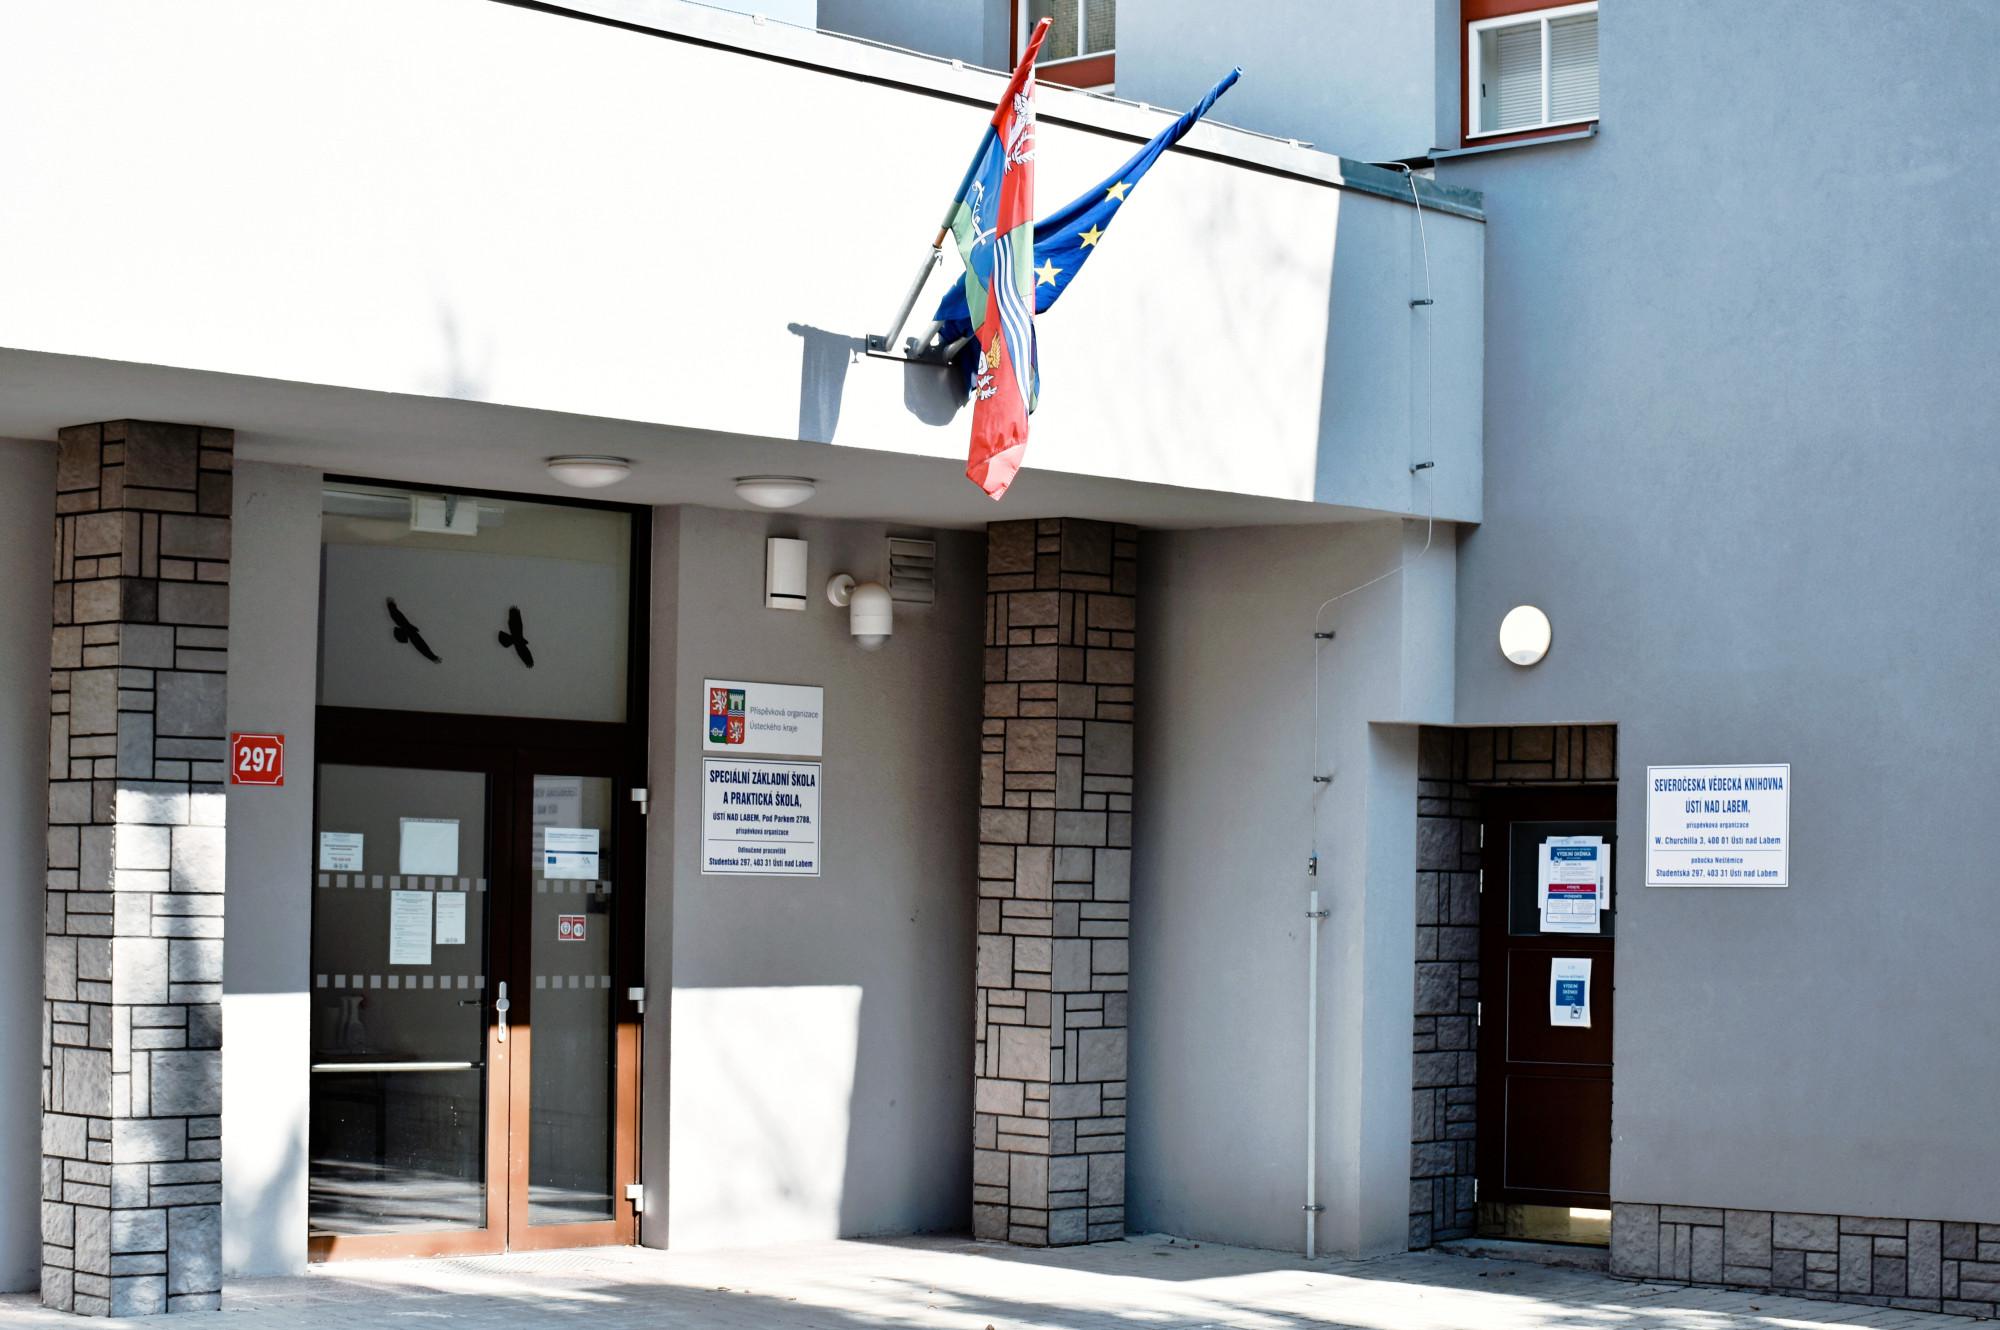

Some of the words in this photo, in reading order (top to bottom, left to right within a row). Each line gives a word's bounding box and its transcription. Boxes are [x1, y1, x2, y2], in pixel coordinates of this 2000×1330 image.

[750, 707, 785, 717] Příspěvková
[787, 709, 819, 719] organizace
[750, 720, 781, 731] Ústeckého
[783, 724, 798, 733] kraje
[240, 746, 277, 772] 297
[710, 768, 750, 784] SPECIÁLNÍ
[752, 769, 789, 786] ZÁKLADNÍ
[792, 771, 815, 787] ŠKOLA
[1654, 775, 1706, 792] SEVEROČESKÁ
[1708, 775, 1742, 791] VĚDECKÁ
[1744, 777, 1783, 790] KNIHOVNA
[723, 792, 728, 804] A
[731, 790, 773, 806] PRAKTICKÁ
[775, 791, 802, 808] ŠKOLA,
[1686, 797, 1702, 813] ÚSTÍ
[1704, 800, 1720, 813] NAD
[1722, 800, 1750, 813] LABEM,
[713, 811, 726, 821] ÚSTÍ
[727, 812, 738, 821] NAD
[762, 814, 772, 823] Pod
[774, 815, 795, 823] Parkem
[1665, 836, 1698, 844] Churchilla
[1731, 835, 1743, 844] Ústí
[709, 857, 739, 866] Studentská
[753, 859, 763, 867] 403
[765, 859, 771, 867] 31
[773, 858, 783, 867] Ústí
[784, 859, 794, 867] nad
[796, 860, 813, 868] Labem
[1656, 869, 1690, 877] Studentská
[1707, 869, 1718, 877] 403
[1720, 869, 1728, 877] 31
[1730, 868, 1742, 877] Ústí
[1743, 869, 1755, 877] nad
[1757, 869, 1778, 877] Labem
